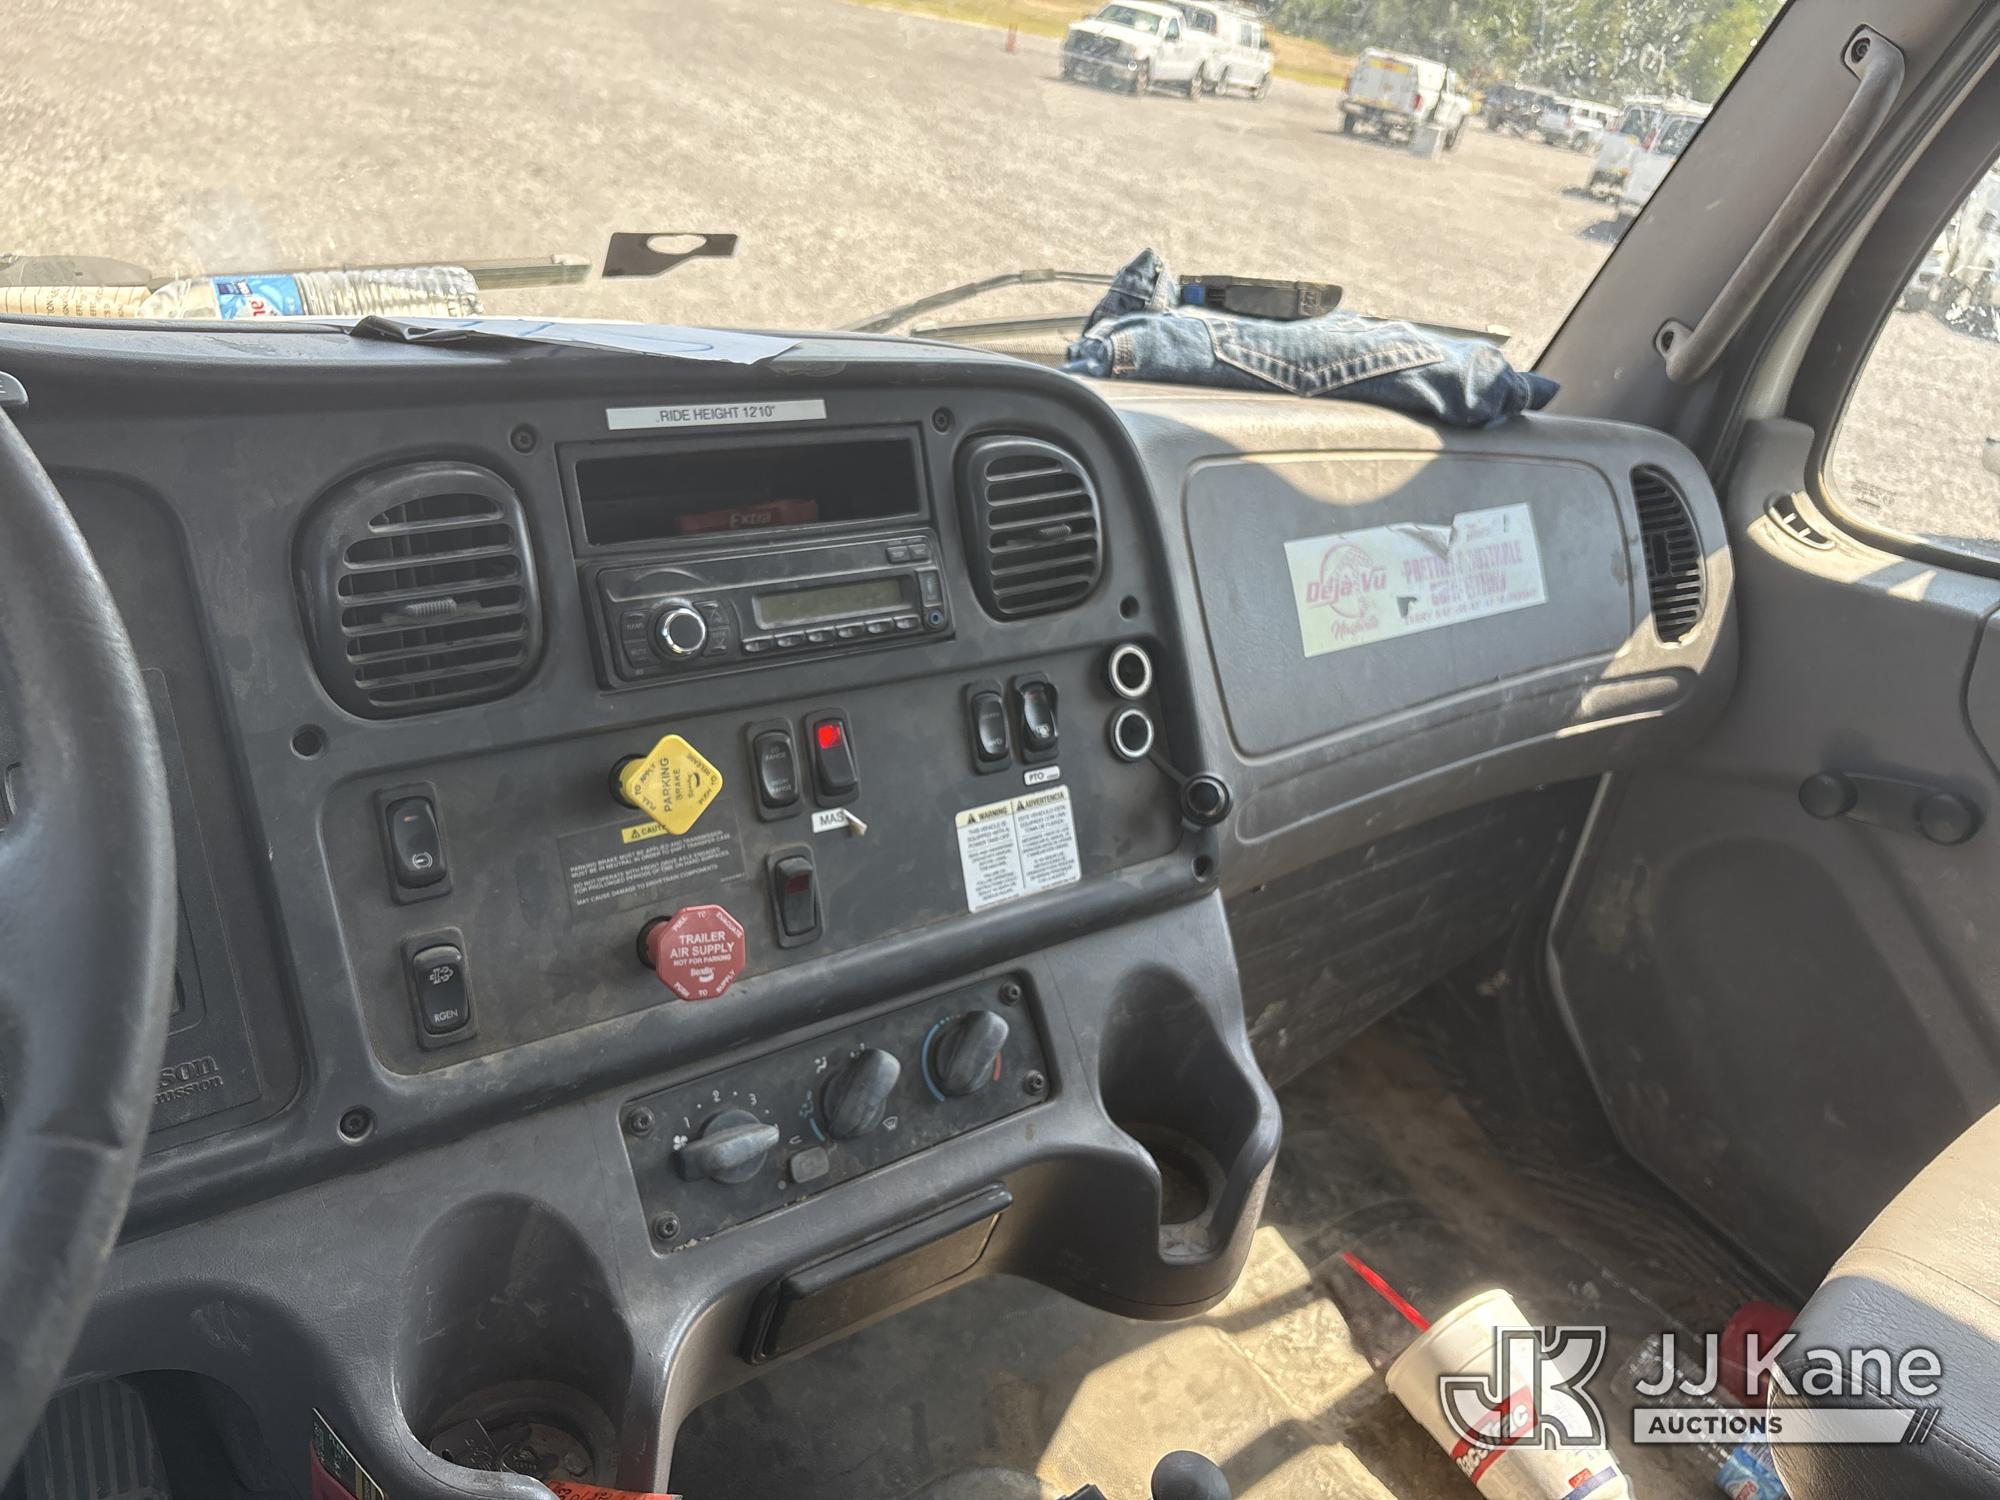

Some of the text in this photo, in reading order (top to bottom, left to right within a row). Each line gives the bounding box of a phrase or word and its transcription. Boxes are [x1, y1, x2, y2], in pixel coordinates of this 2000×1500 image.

[660, 409, 691, 422] RIDE
[693, 407, 739, 421] HEIGHT
[730, 511, 772, 529] Extra
[1028, 771, 1044, 782] PTO
[660, 757, 673, 812] PARKING
[673, 768, 683, 801] BRAKE
[1025, 791, 1065, 809] ADVERTENCIA
[978, 806, 1008, 821] WARNING
[679, 930, 726, 945] TRAILER
[670, 942, 735, 959] AIR SUPPLY
[673, 954, 732, 967] NOT FOR PARKING
[434, 1009, 458, 1022] RGEN
[712, 1089, 721, 1102] 2
[749, 1093, 757, 1106] 3
